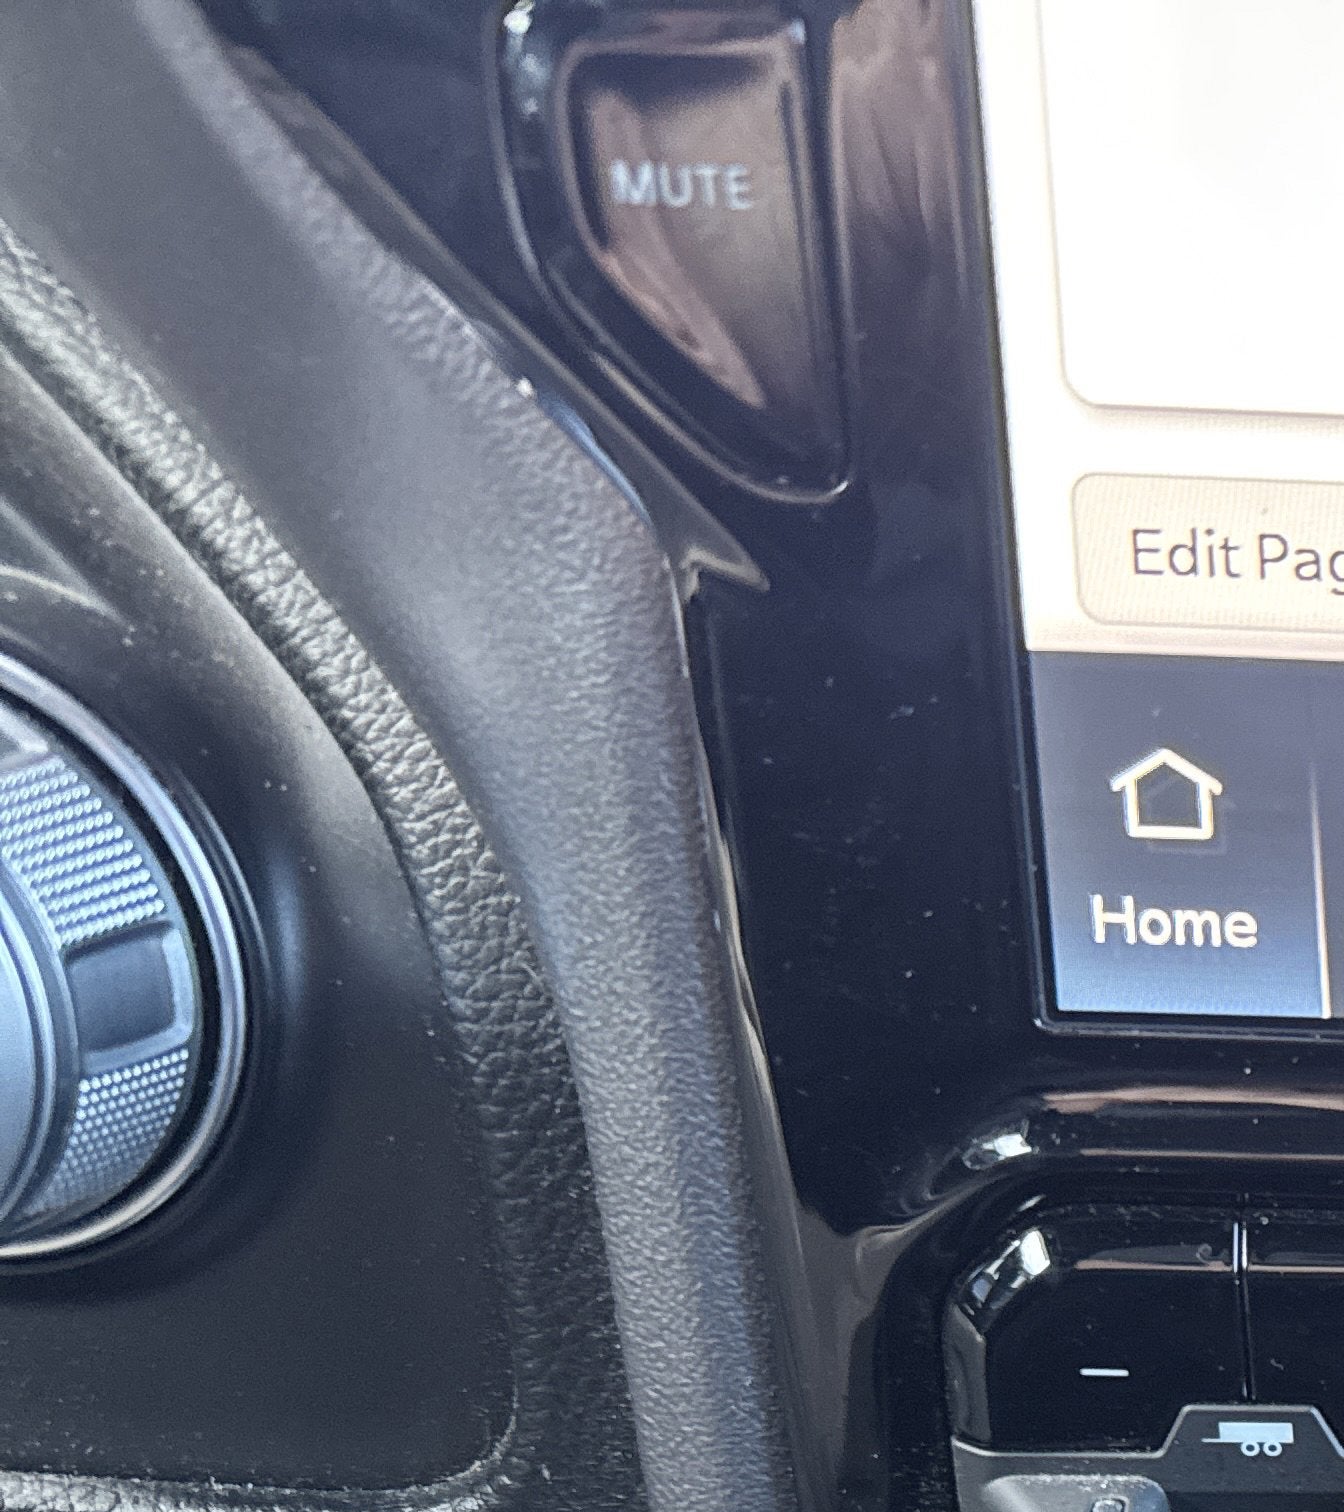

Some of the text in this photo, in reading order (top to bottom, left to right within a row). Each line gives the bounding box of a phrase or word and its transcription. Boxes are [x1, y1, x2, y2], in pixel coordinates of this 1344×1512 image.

[610, 159, 751, 209] MUTE
[1132, 527, 1241, 578] Edit
[1090, 894, 1258, 948] Home
